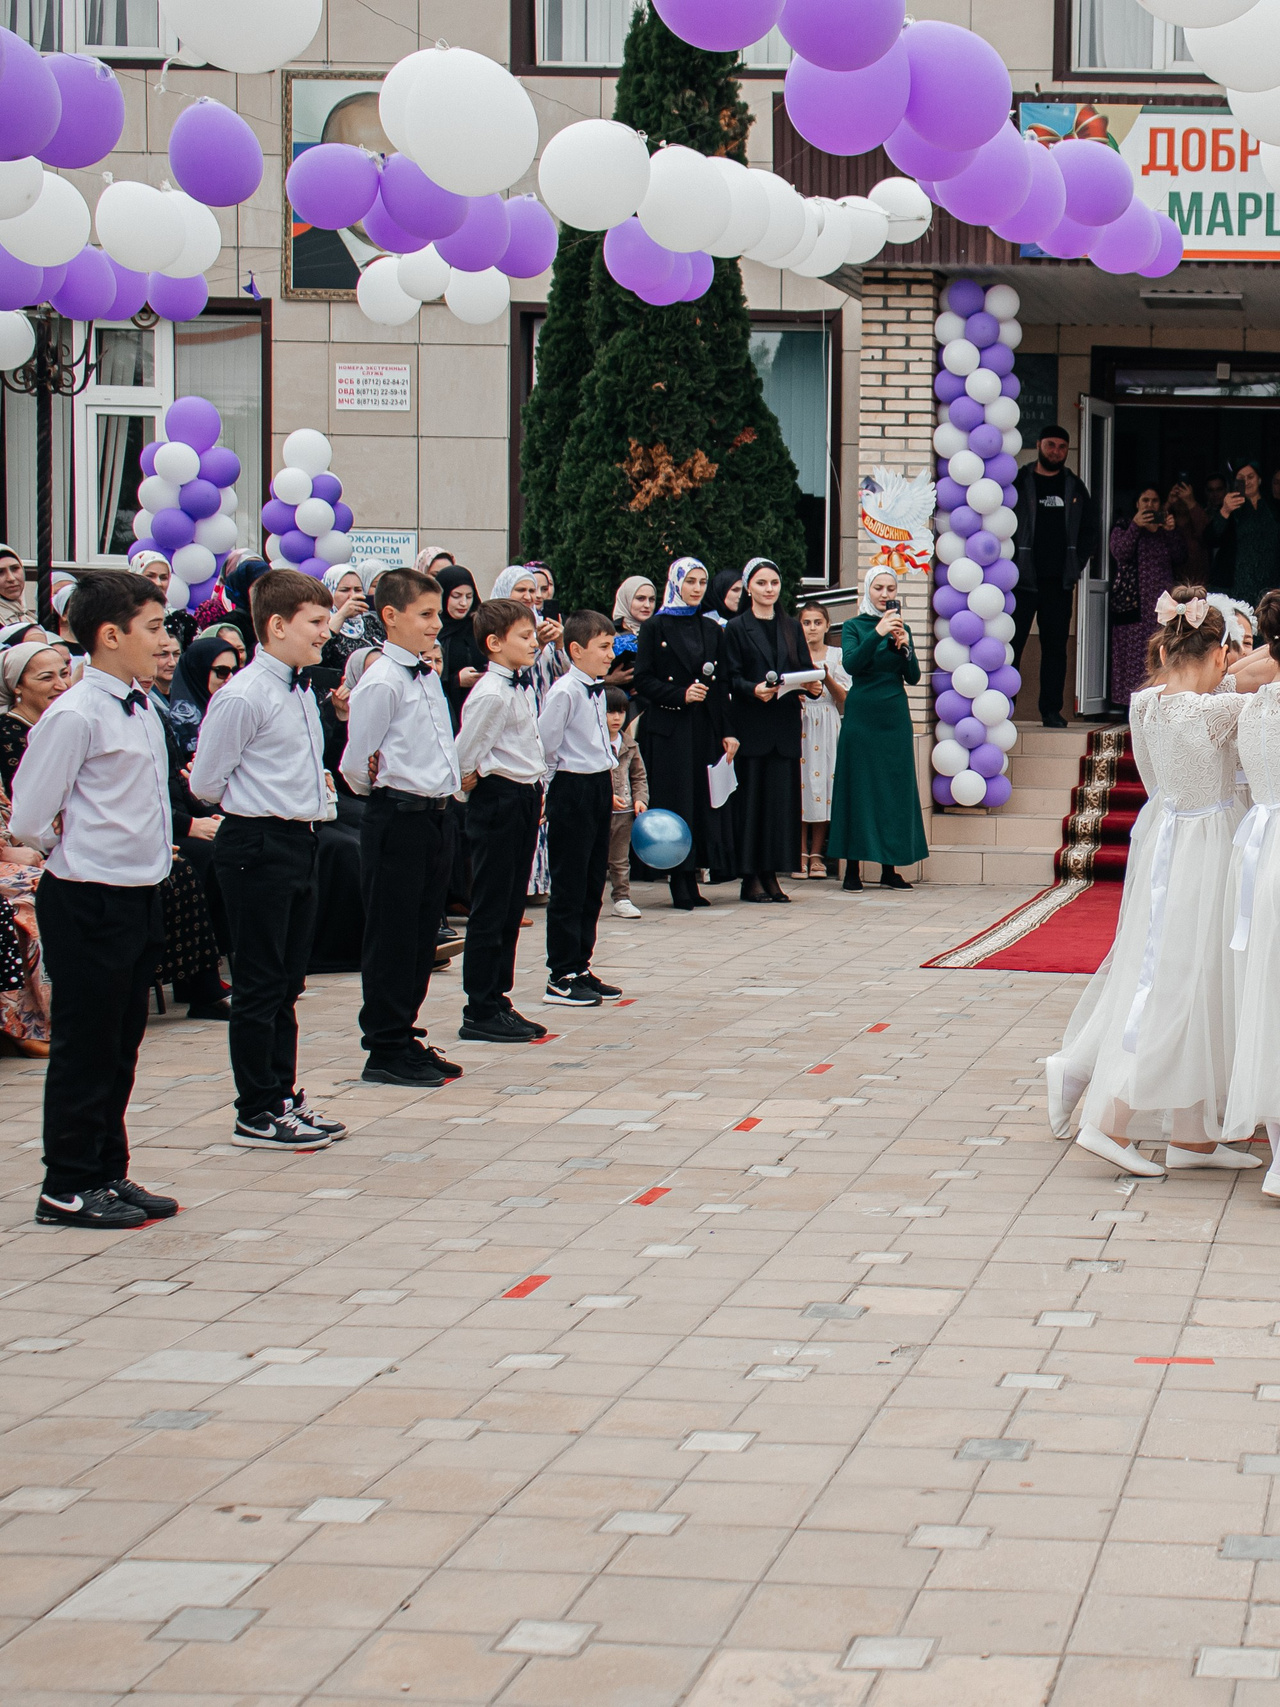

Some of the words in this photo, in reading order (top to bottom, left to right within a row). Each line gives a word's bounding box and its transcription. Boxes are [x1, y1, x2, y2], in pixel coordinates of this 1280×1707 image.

[1141, 127, 1260, 176] ДОБР
[338, 388, 355, 396] ОВД
[347, 534, 411, 544] ОЖАРНЫЙ
[351, 545, 400, 555] ОДОЕМ
